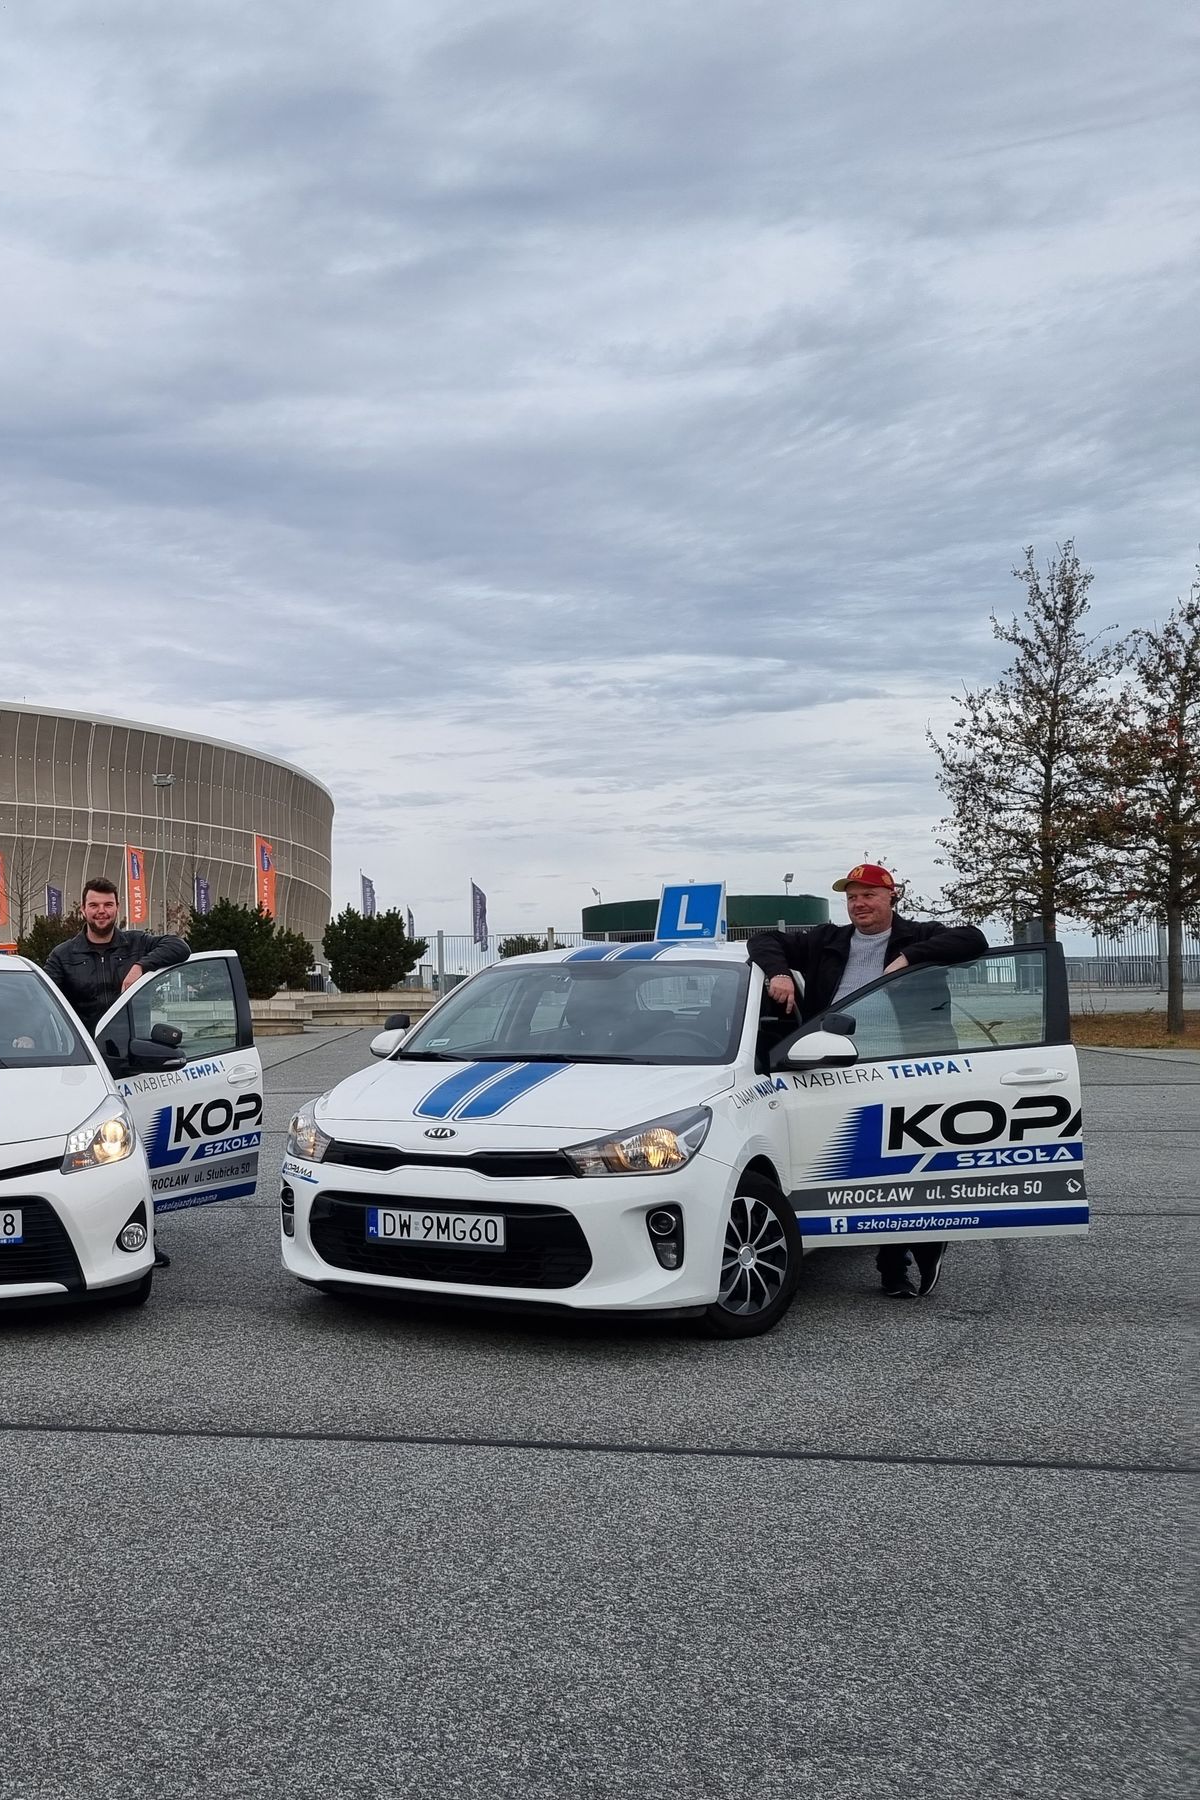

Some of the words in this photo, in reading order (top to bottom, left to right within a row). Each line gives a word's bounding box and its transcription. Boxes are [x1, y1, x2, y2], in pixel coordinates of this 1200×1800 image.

[677, 894, 703, 931] L
[133, 1071, 183, 1094] NABIERA
[183, 1061, 220, 1081] TEMPA
[792, 1068, 884, 1089] NABIERA
[888, 1059, 960, 1079] TEMPA
[174, 1092, 263, 1143] KOP
[204, 1134, 259, 1156] SZKOŁA
[427, 1129, 451, 1137] KIA
[956, 1146, 1074, 1167] SZKOŁA
[151, 1173, 190, 1191] ROCŁAW
[194, 1171, 204, 1183] ul.
[206, 1165, 239, 1180] Słubicka
[241, 1162, 250, 1174] 50
[827, 1187, 914, 1205] WROCŁAW
[926, 1186, 946, 1200] ul.
[950, 1182, 1019, 1198] Słubicka
[1023, 1180, 1043, 1194] 50
[383, 1212, 411, 1238] DW
[422, 1215, 498, 1243] 9MG60
[857, 1215, 980, 1231] szkolajazdykopama
